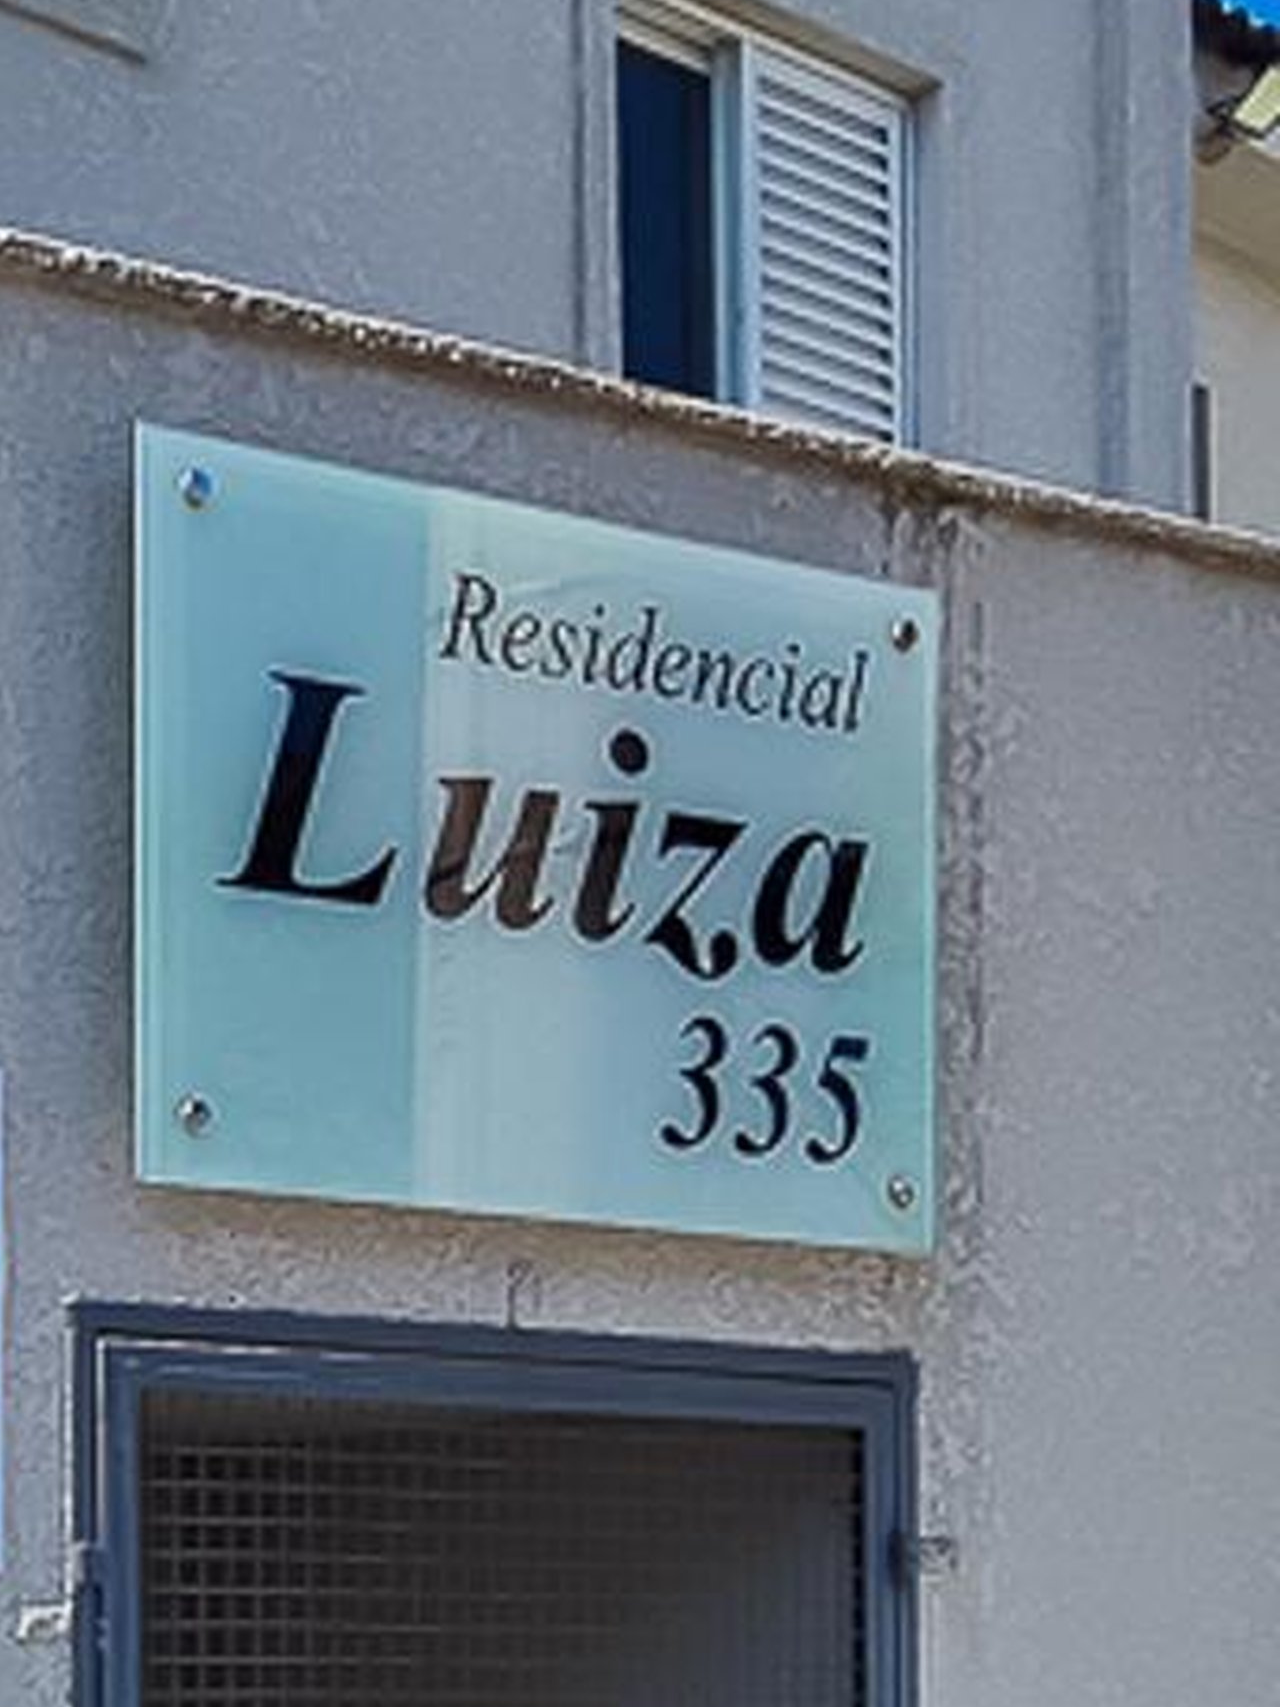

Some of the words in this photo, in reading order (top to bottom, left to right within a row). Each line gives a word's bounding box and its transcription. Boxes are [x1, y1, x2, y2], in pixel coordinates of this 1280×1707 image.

[439, 574, 870, 731] Residencial
[215, 668, 869, 981] Luiza
[658, 1015, 870, 1166] 335
